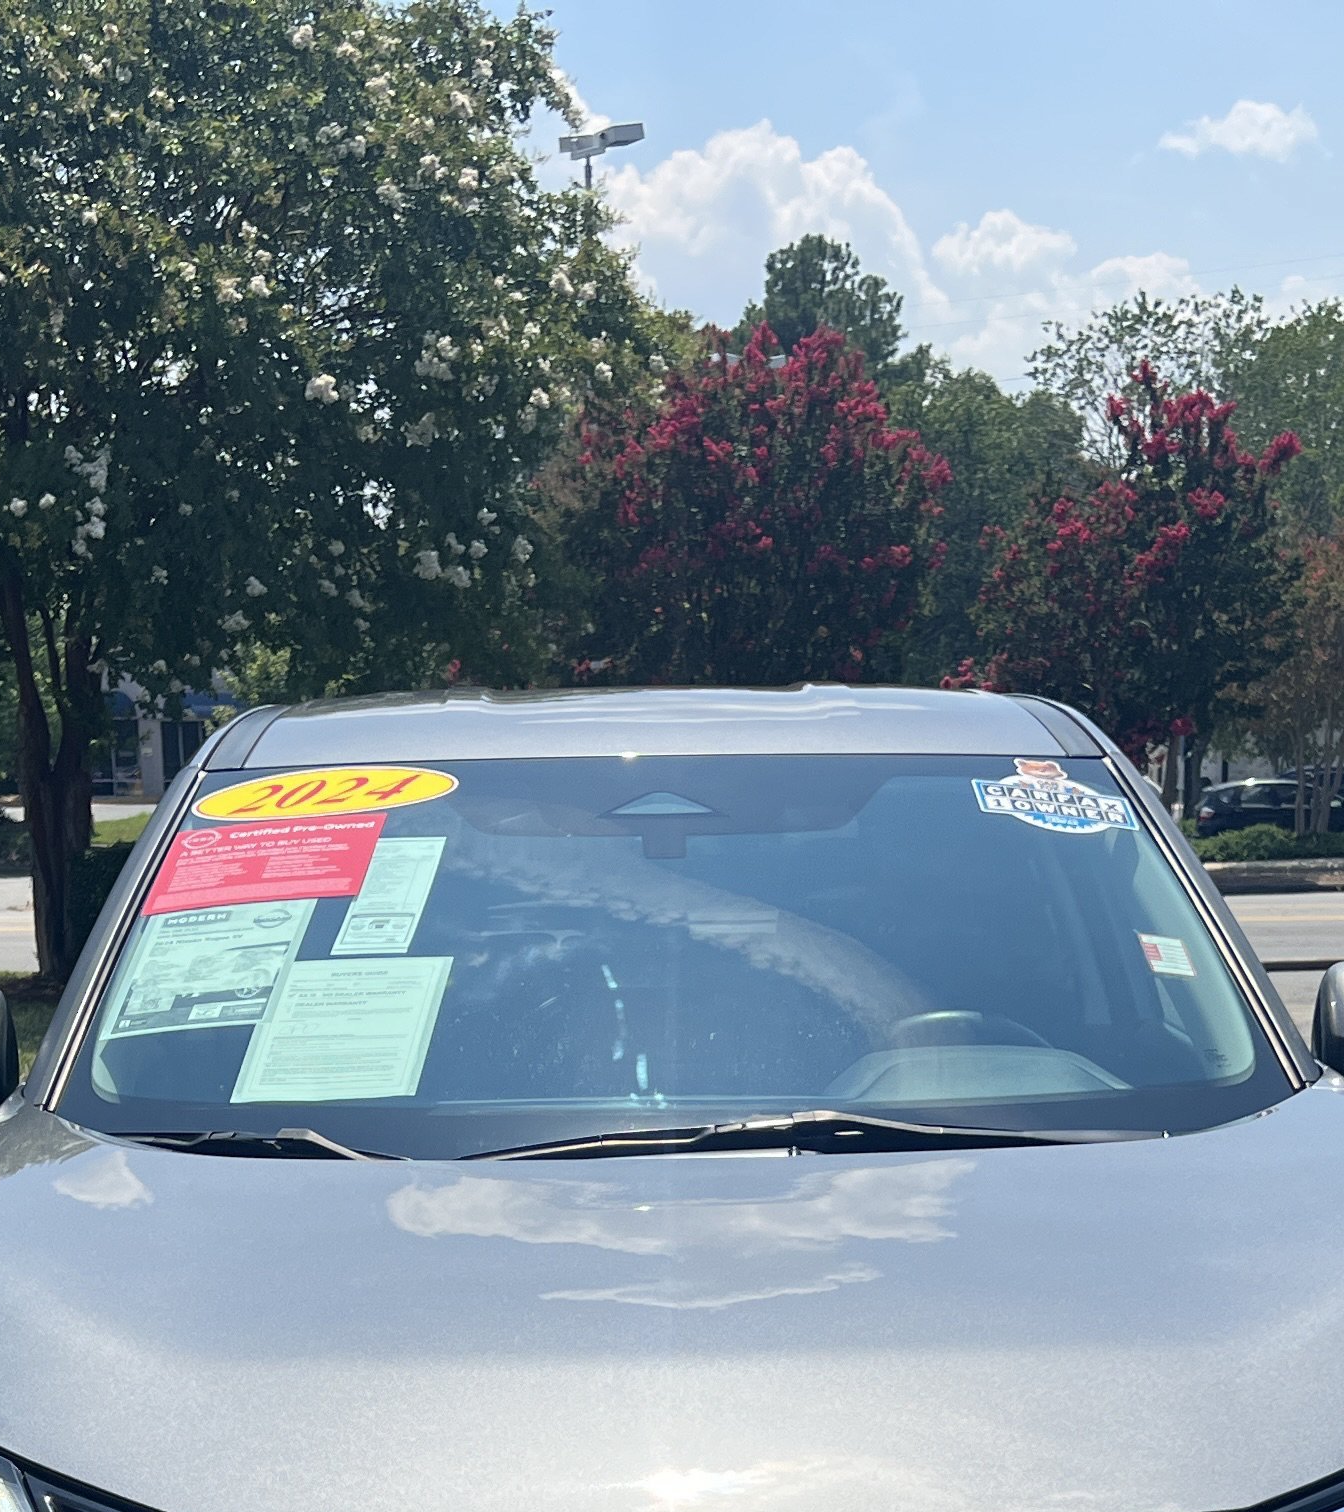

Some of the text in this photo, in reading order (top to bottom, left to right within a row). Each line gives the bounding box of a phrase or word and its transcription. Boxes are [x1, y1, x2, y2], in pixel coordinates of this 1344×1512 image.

[226, 774, 422, 816] 2024
[985, 785, 1124, 812] CARFAX
[1013, 800, 1128, 823] OWNER
[229, 820, 376, 839] Certified Pre-Owned
[166, 912, 227, 926] MODERN
